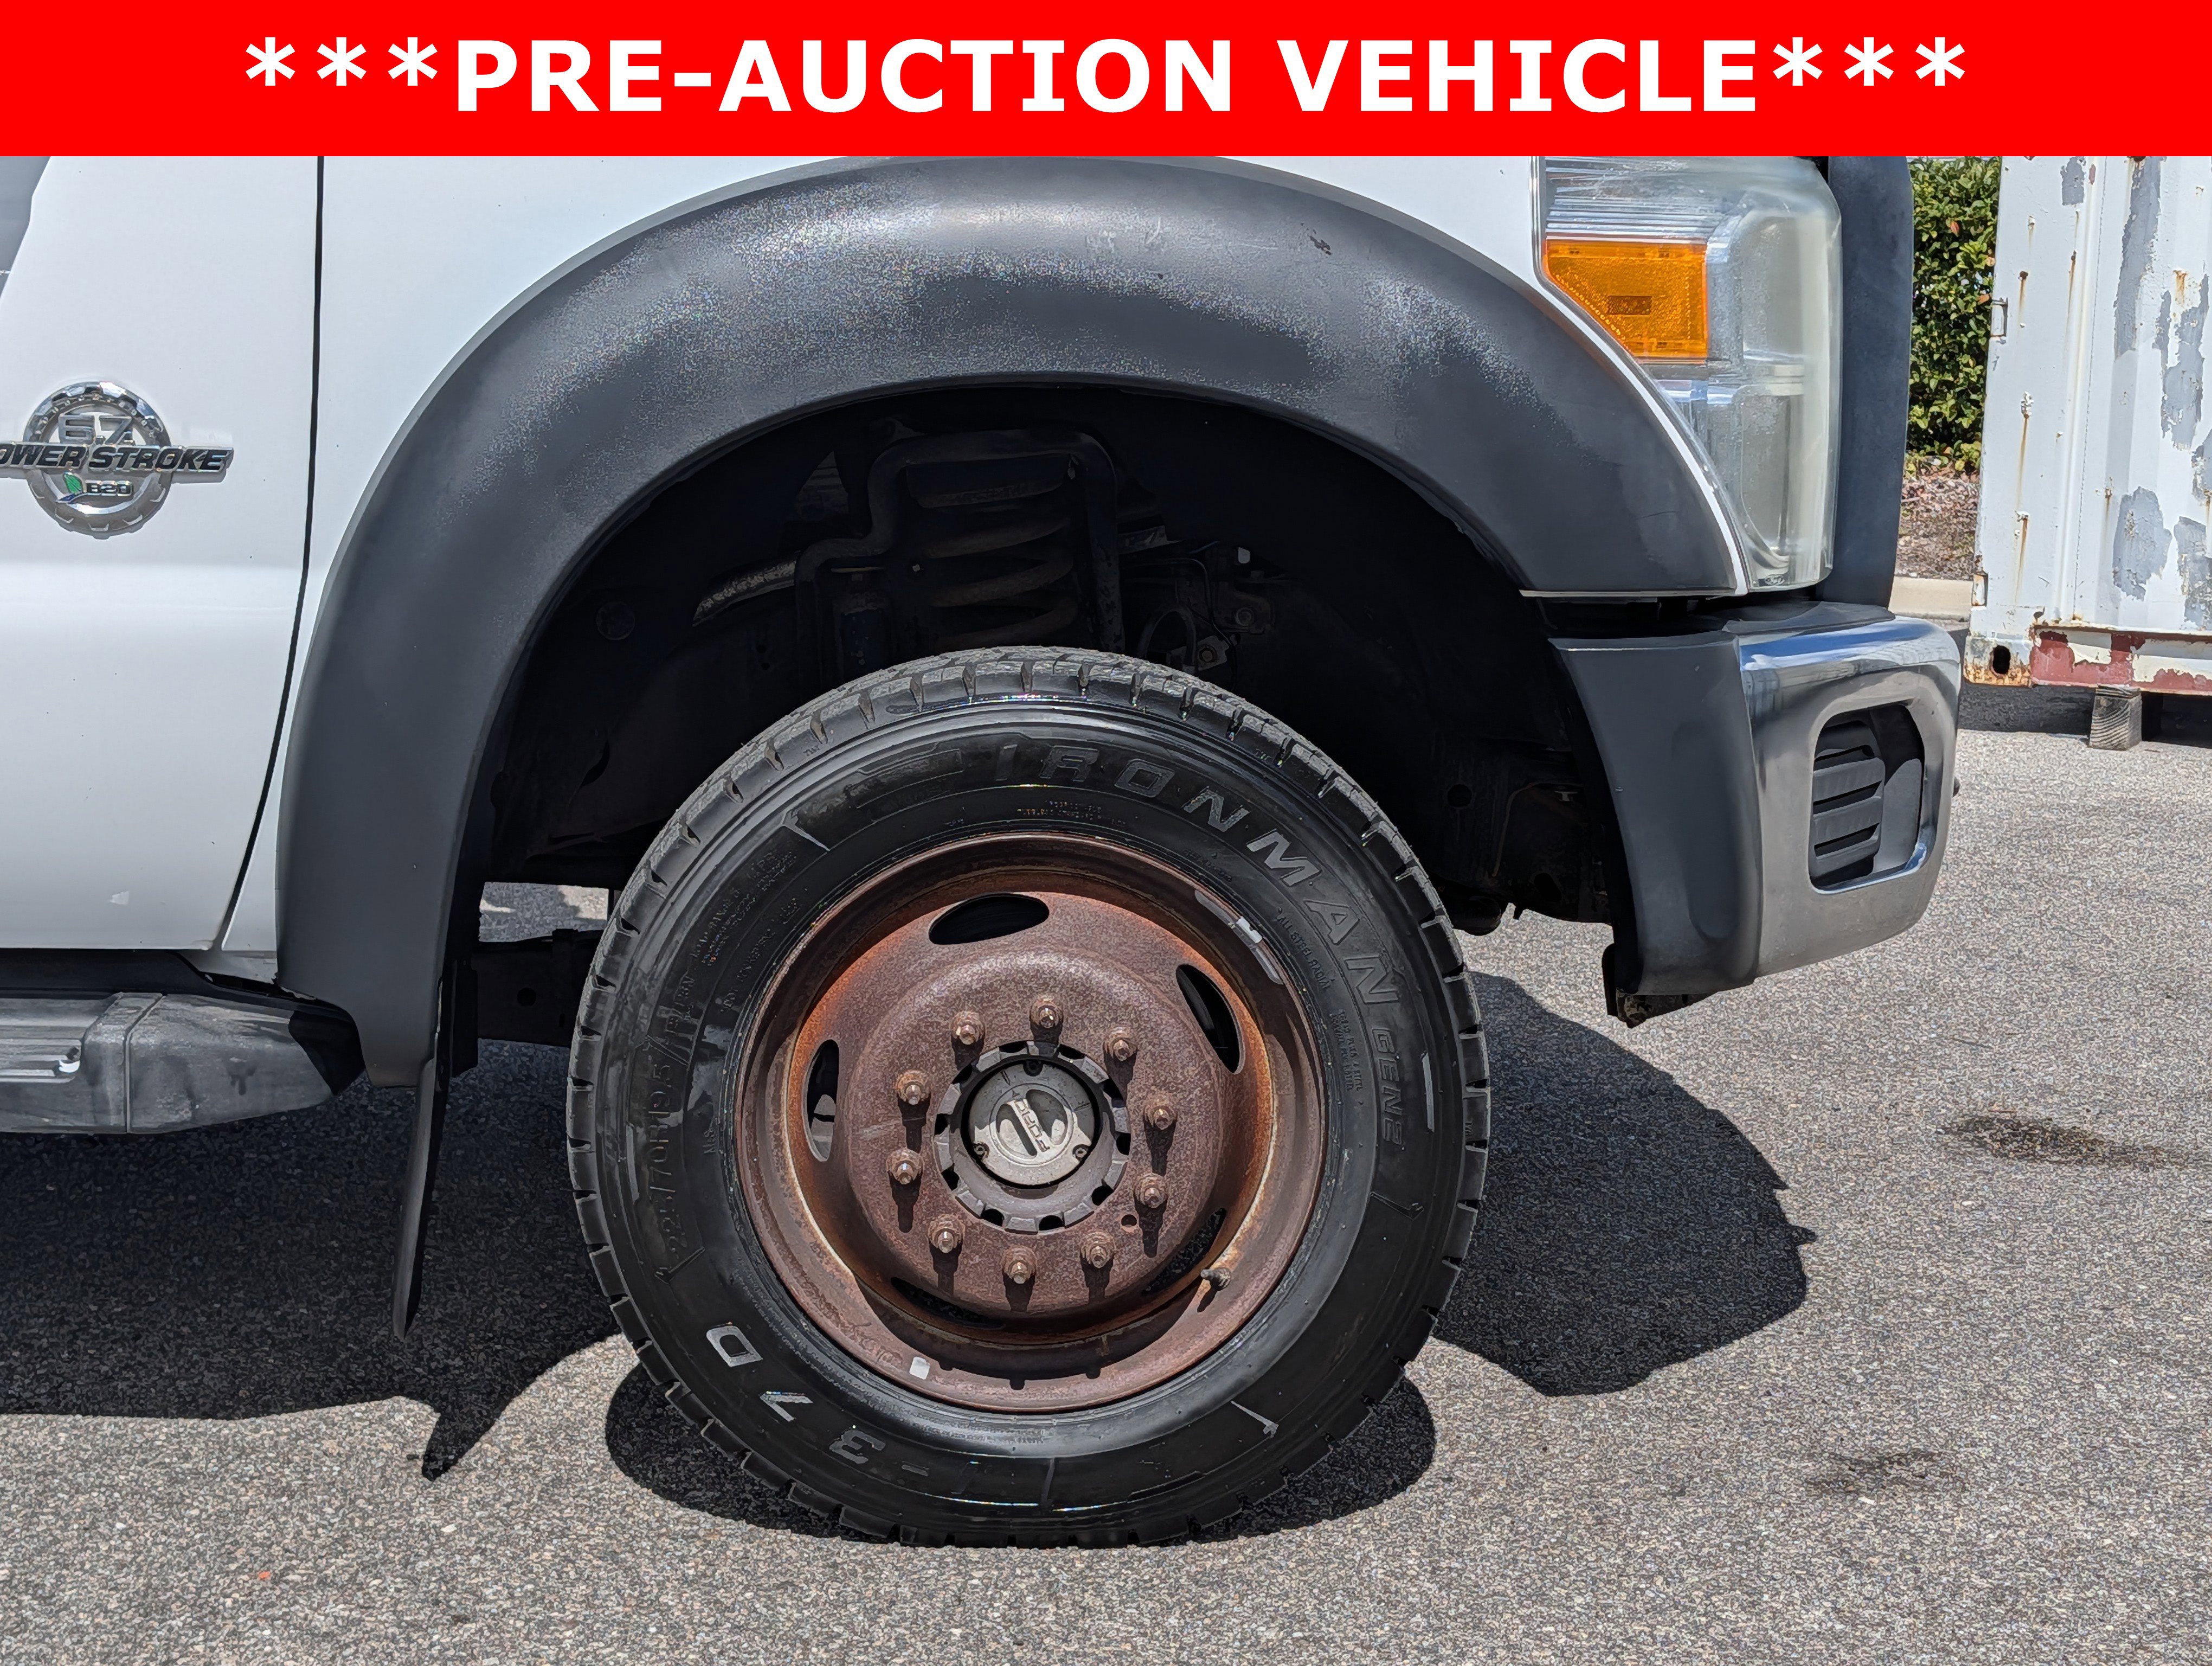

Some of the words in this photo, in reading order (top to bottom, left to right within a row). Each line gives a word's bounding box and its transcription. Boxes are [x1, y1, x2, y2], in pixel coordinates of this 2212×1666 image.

[0, 443, 85, 469] OWER
[88, 445, 232, 473] STROKE
[995, 744, 1399, 1003] IRONMAN
